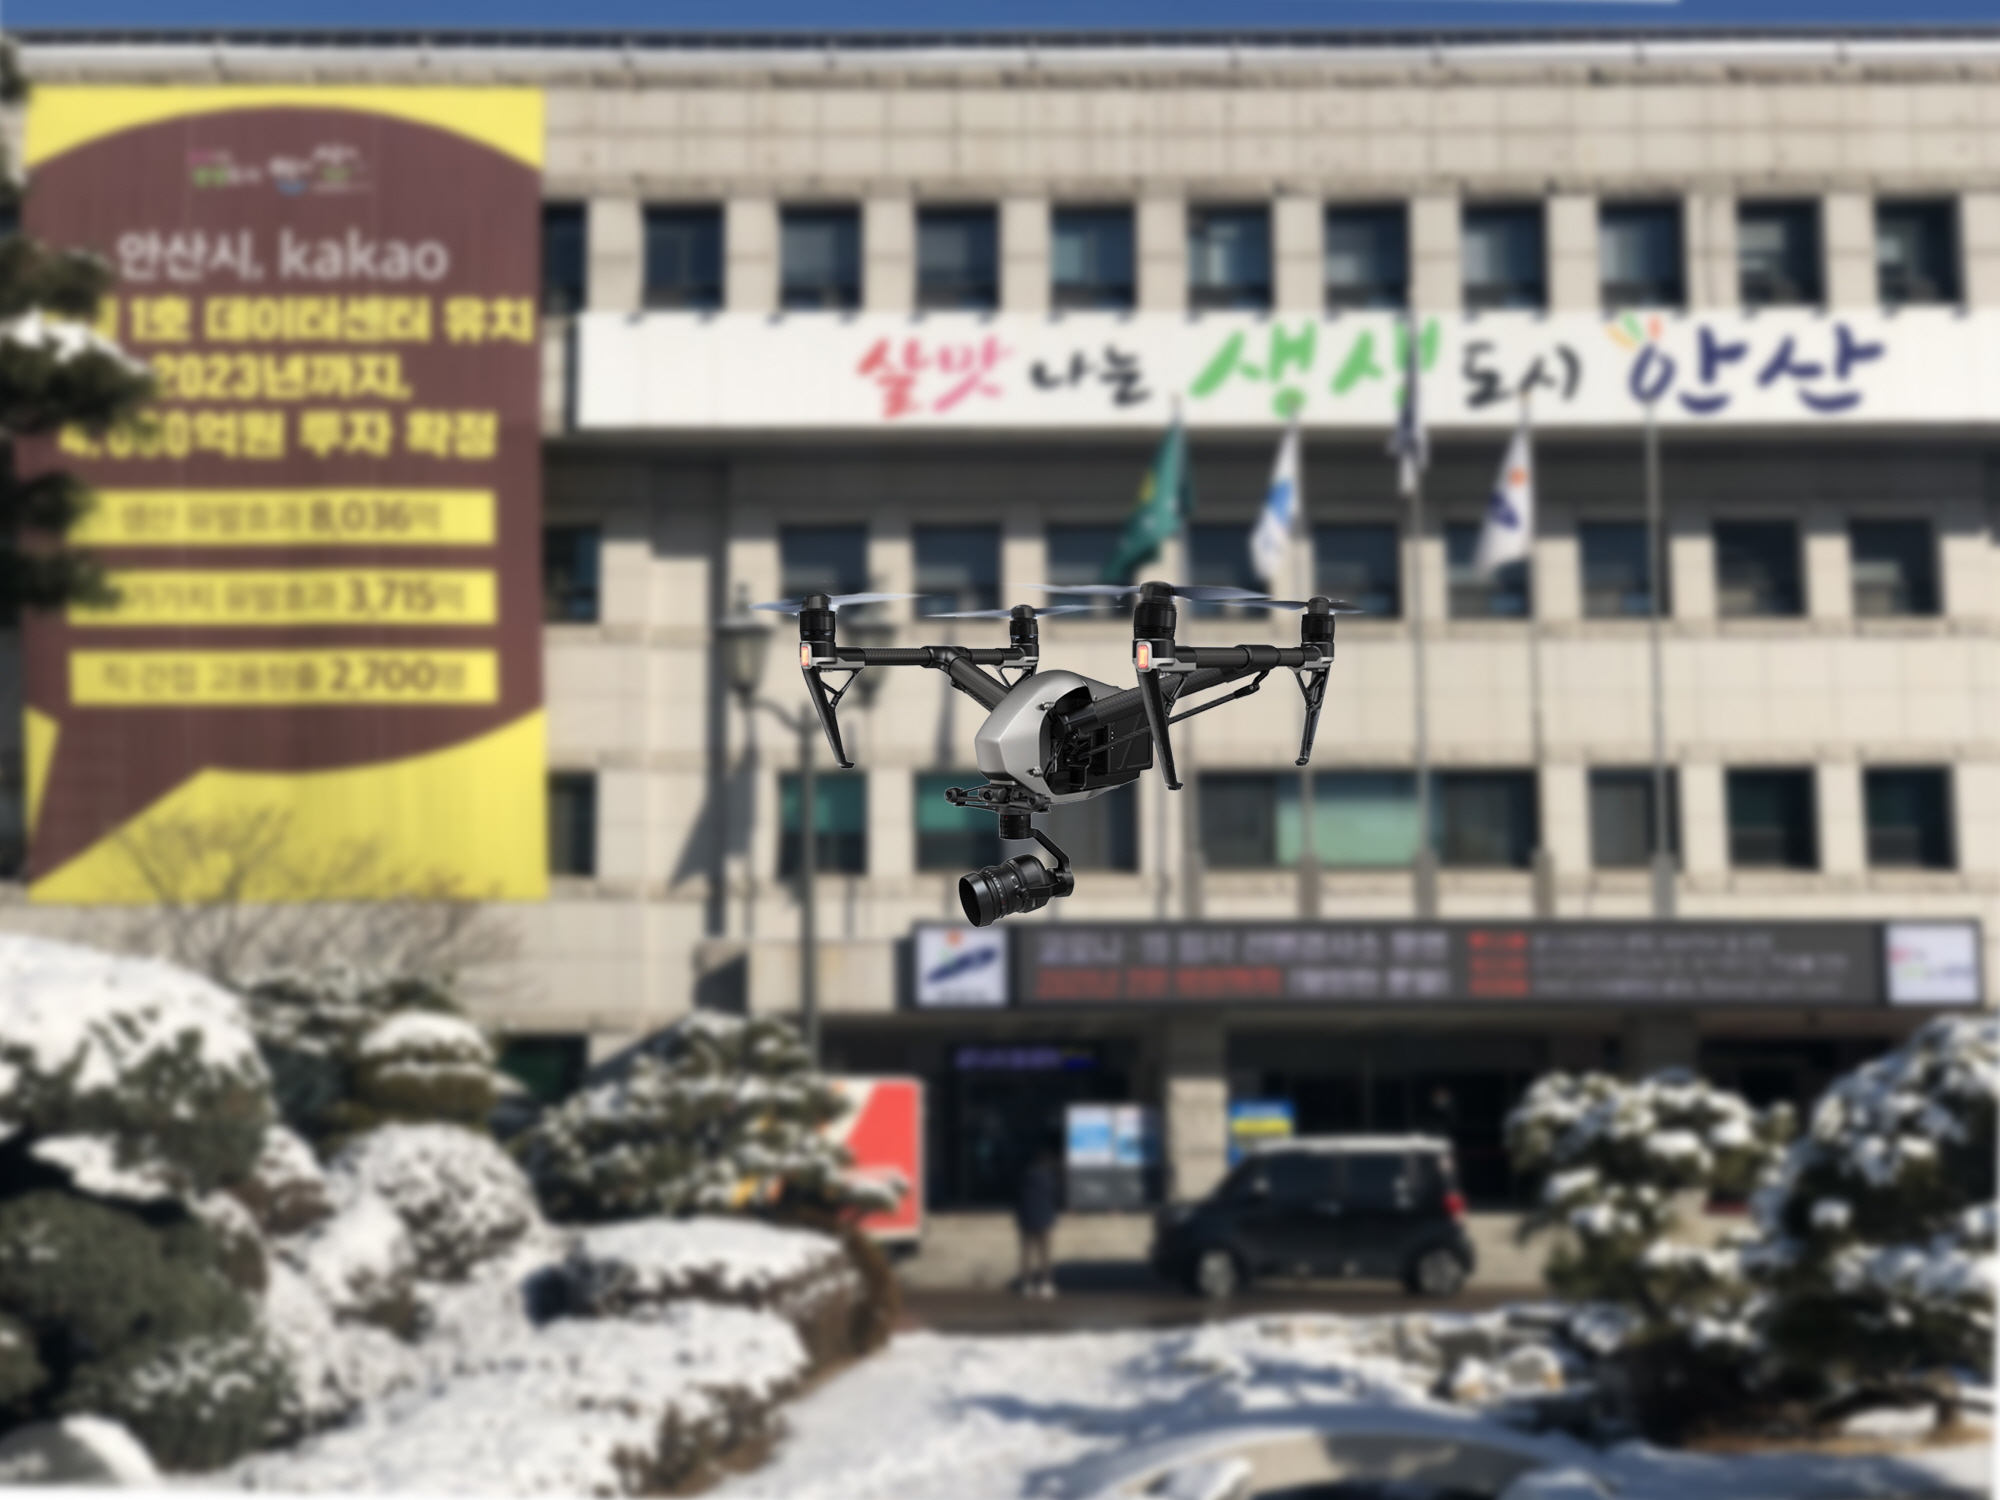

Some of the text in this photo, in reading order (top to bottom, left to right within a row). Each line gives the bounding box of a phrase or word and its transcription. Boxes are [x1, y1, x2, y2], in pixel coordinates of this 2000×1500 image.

[118, 230, 449, 281] 안산시, kakao
[205, 296, 431, 342] 데이터센터
[445, 297, 535, 343] 유치
[857, 334, 1008, 420] 살맛
[1189, 320, 1440, 420] 생생
[1462, 341, 1580, 409] 도시
[1629, 323, 1884, 414] 안산
[301, 410, 393, 456] 투자
